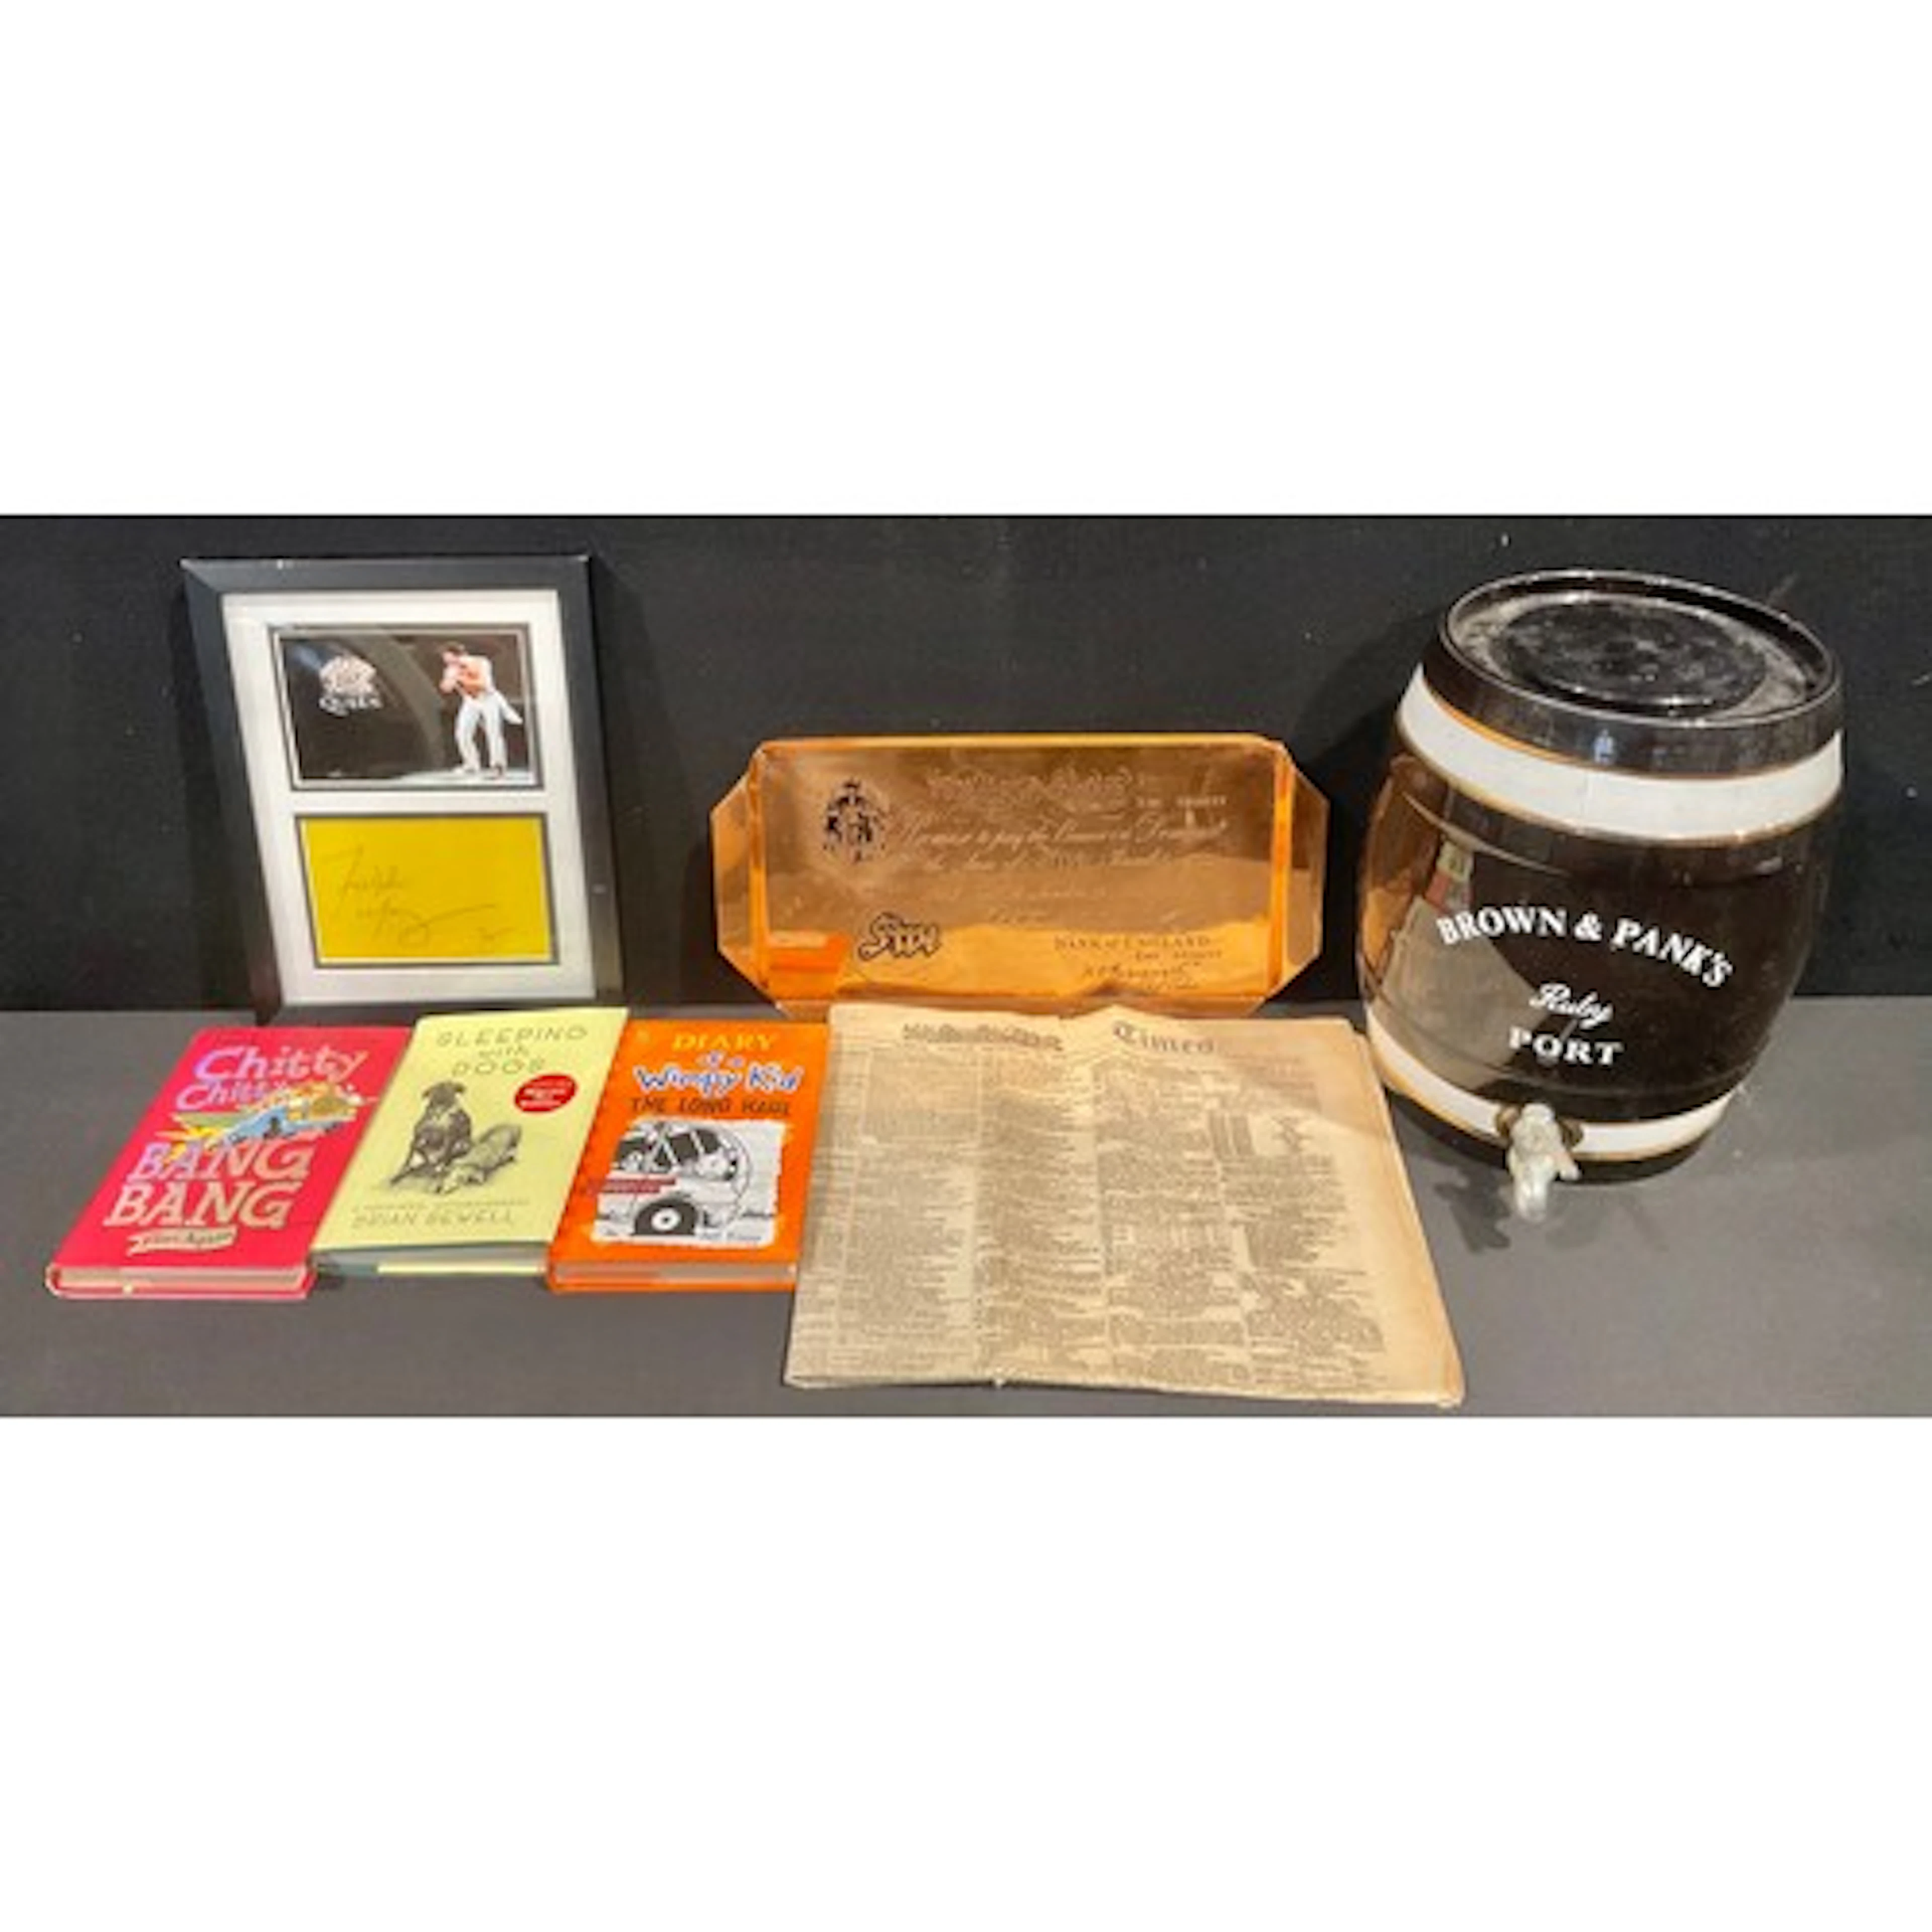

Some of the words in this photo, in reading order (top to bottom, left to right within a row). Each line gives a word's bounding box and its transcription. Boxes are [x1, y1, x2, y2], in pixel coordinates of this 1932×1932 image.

[1436, 906, 1567, 945] BROWN
[1573, 912, 1603, 942] &
[1611, 918, 1733, 987] PANK'S
[1528, 982, 1613, 1030] Ruby
[192, 1044, 369, 1083] Chitty
[671, 1033, 777, 1054] DIARY
[1509, 1026, 1624, 1066] PORT
[745, 1060, 806, 1095] Kid
[126, 1129, 326, 1181] BANG
[102, 1180, 304, 1230] BANG
